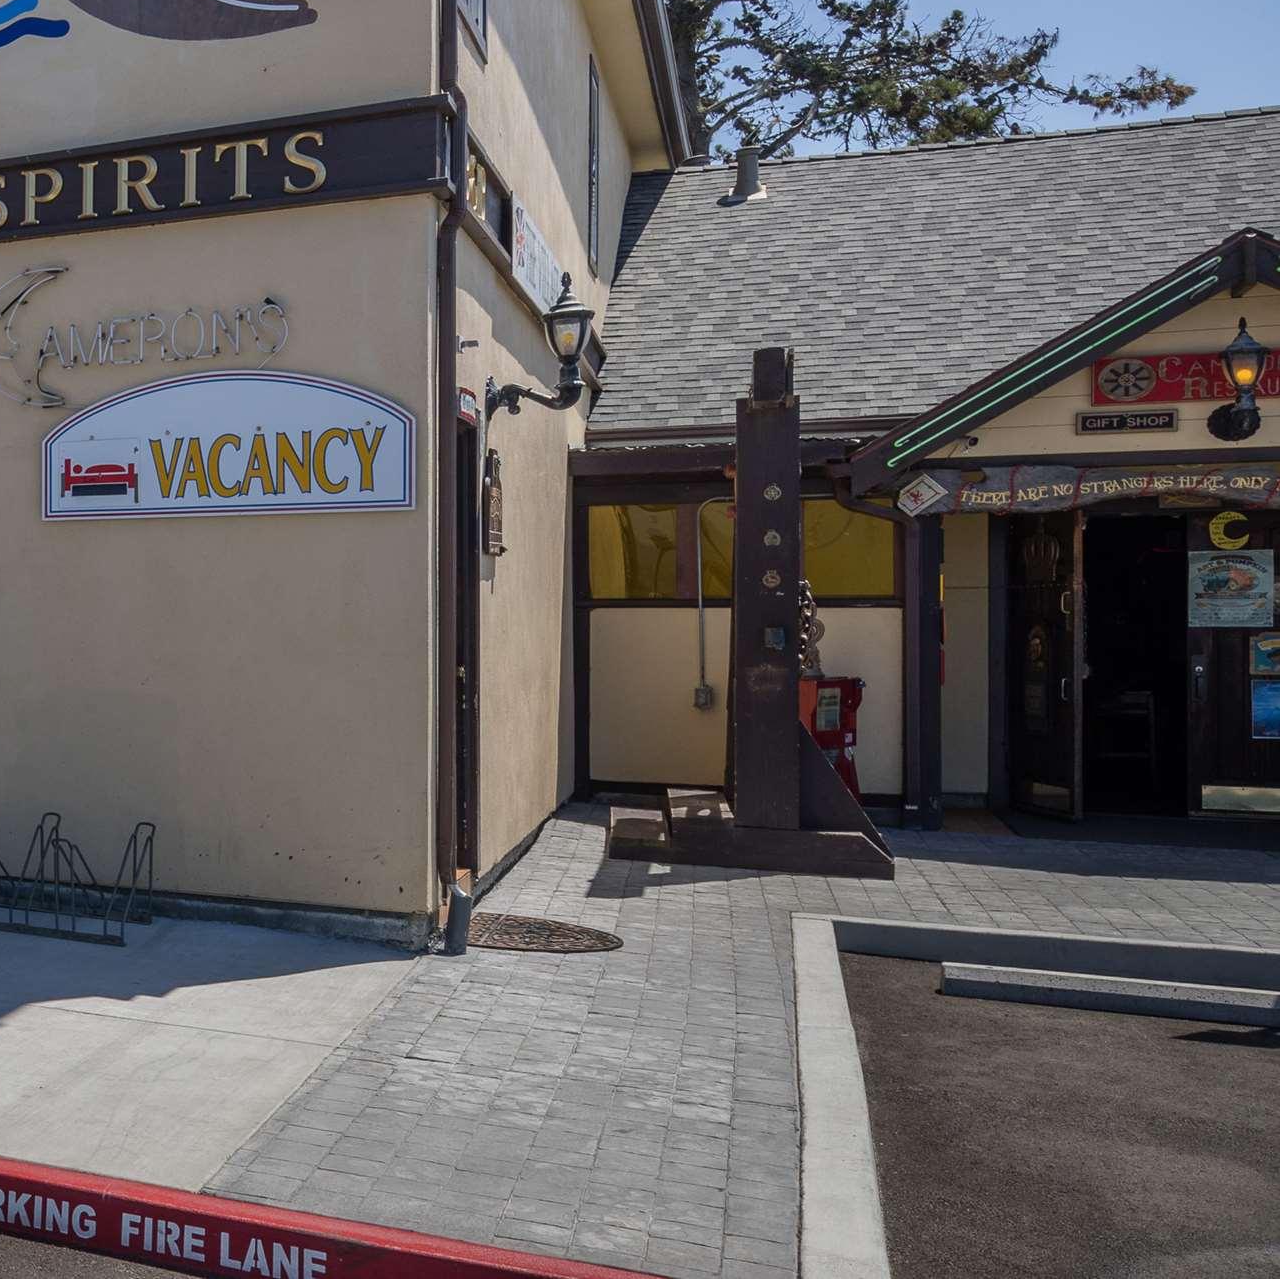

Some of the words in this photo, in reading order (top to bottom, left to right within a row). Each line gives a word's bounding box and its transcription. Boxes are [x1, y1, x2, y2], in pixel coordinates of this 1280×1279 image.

[1085, 417, 1120, 429] GIFT
[1126, 415, 1170, 428] SHOP
[148, 425, 387, 499] VACANCY
[1017, 486, 1048, 501] ARE
[1052, 484, 1073, 496] NO
[1230, 477, 1270, 489] ONLY
[120, 1212, 206, 1263] FIRE
[219, 1231, 328, 1278] LANE
